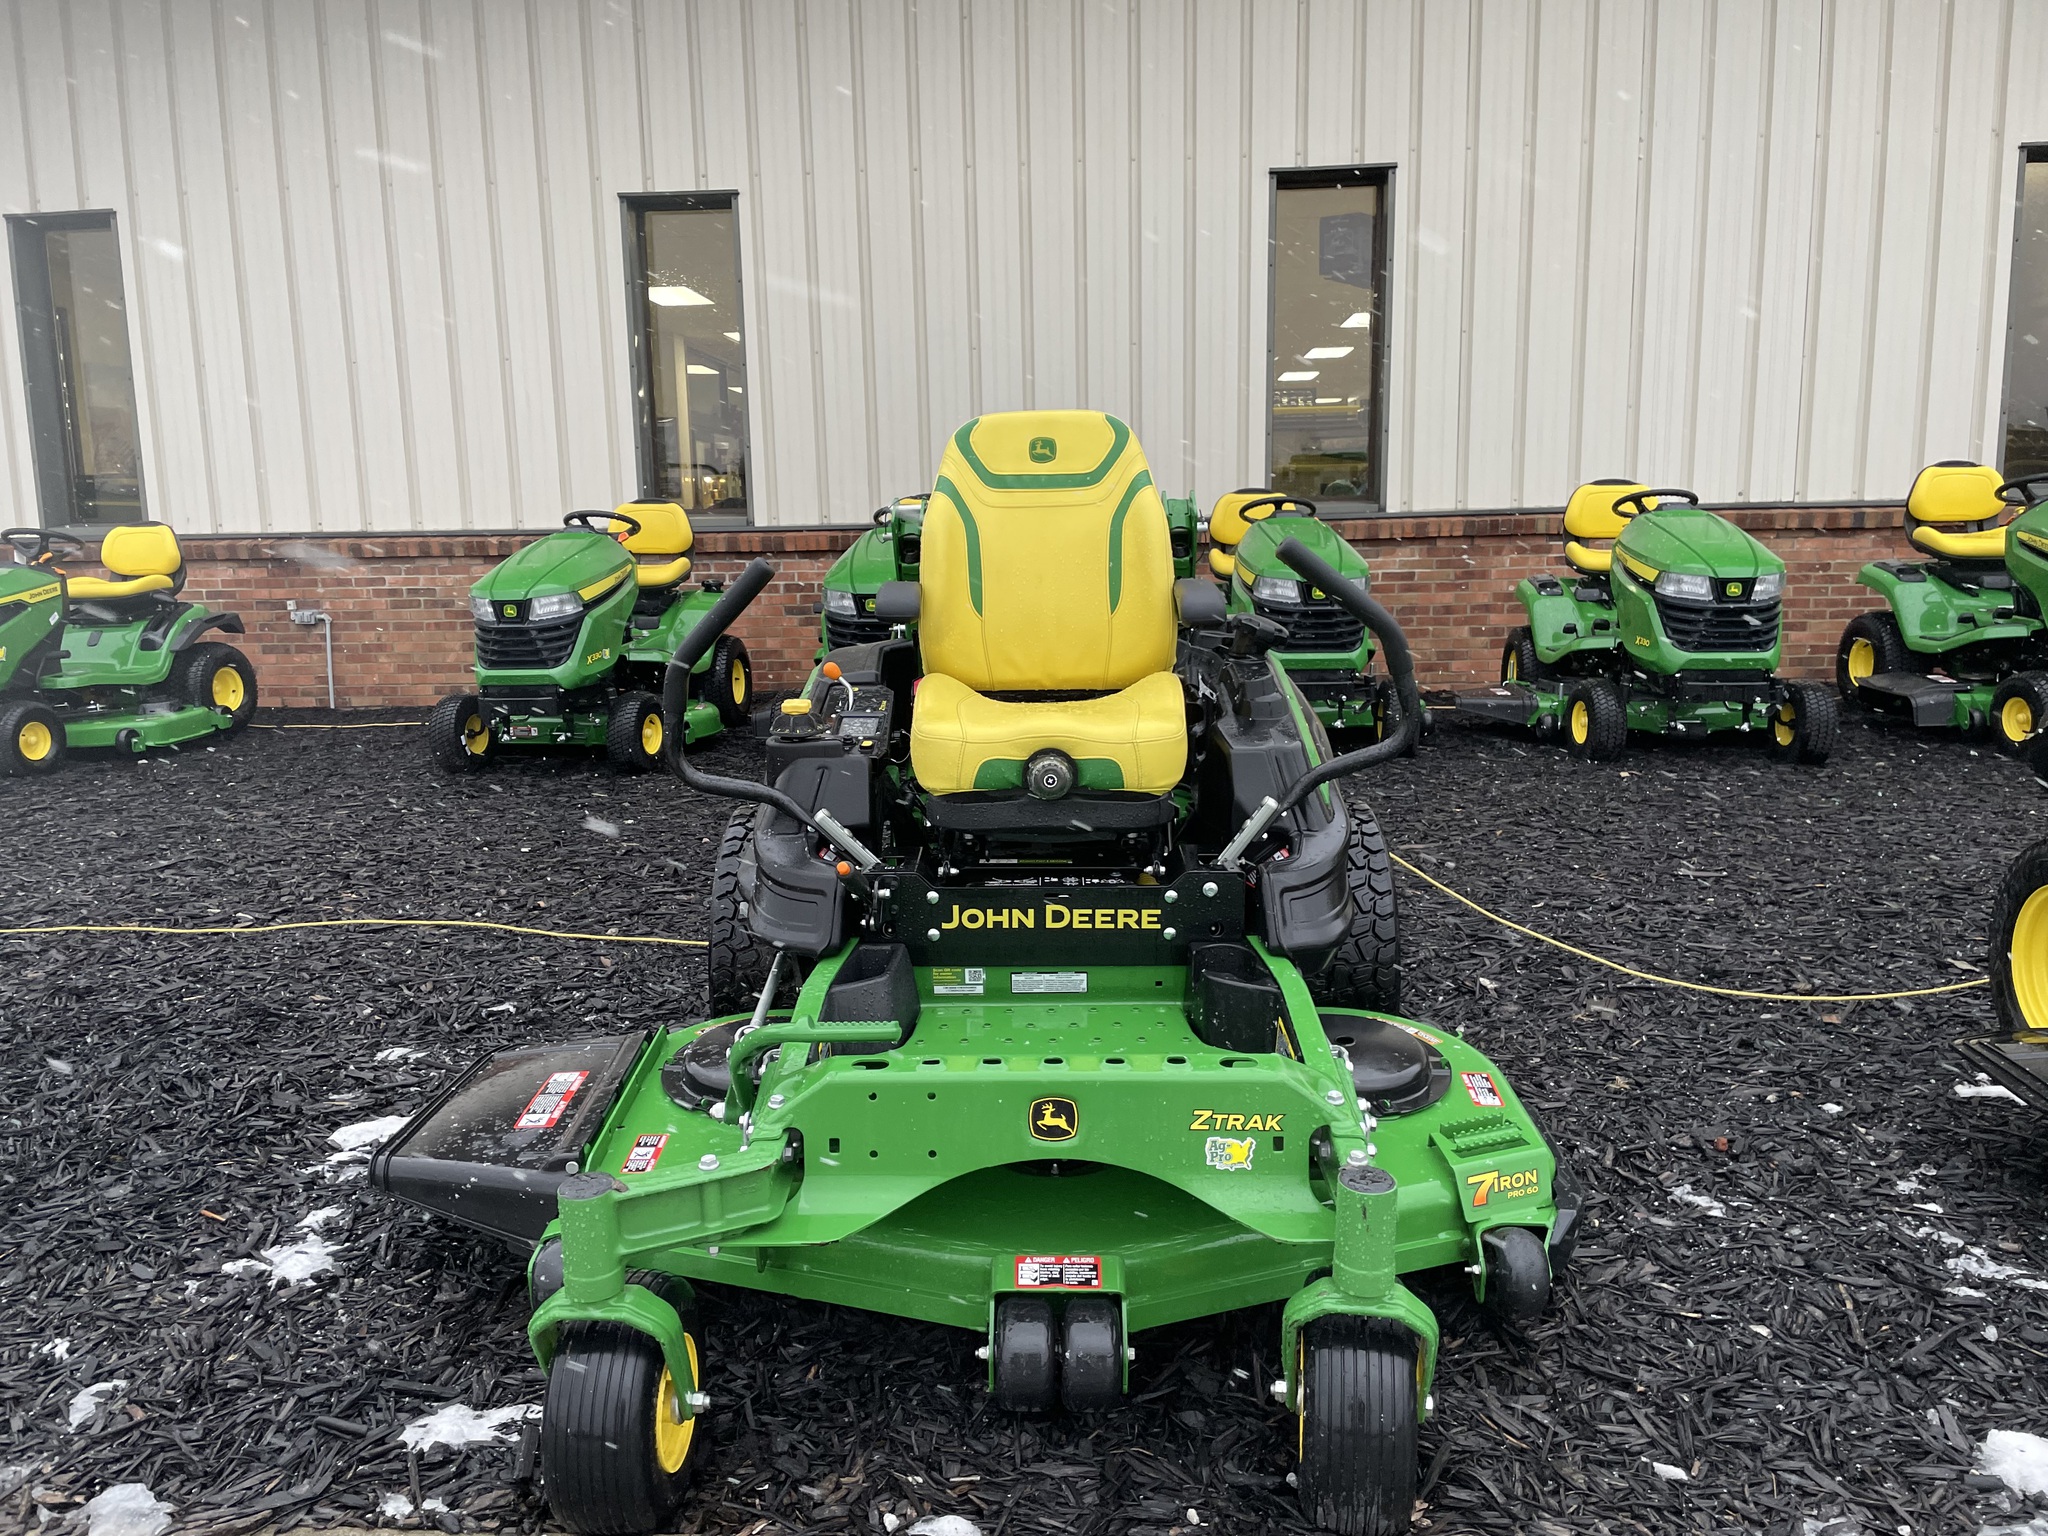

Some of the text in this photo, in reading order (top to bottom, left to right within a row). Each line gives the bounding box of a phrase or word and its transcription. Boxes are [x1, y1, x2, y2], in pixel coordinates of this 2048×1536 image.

[29, 591, 43, 600] JOHN
[941, 904, 1162, 930] JOHN DEERE
[1189, 1109, 1285, 1131] ZTRAK
[1209, 1151, 1232, 1162] Pro
[1507, 1185, 1539, 1200] PRO 60
